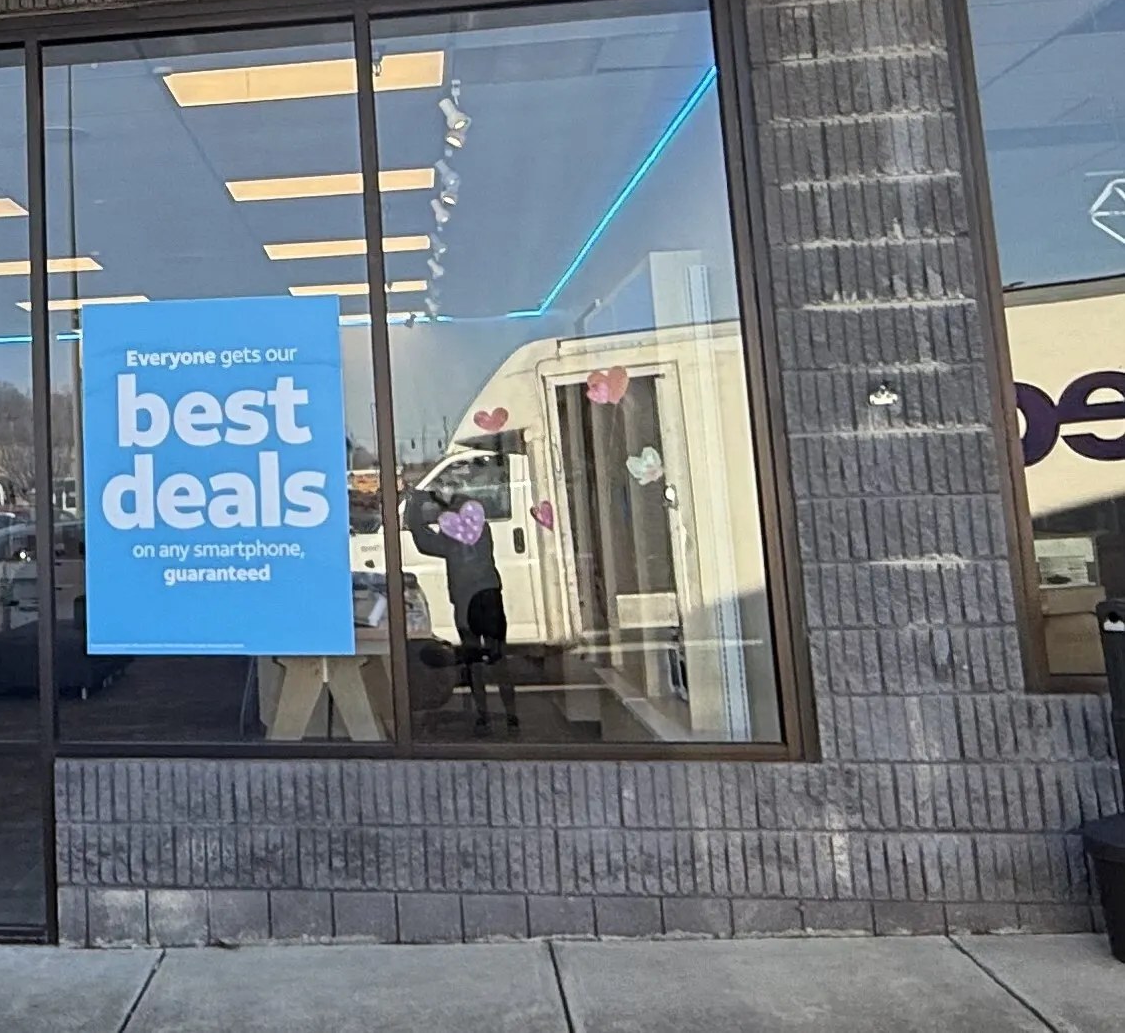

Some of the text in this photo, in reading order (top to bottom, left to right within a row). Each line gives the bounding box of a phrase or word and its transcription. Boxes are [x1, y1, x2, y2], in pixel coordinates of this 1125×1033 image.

[127, 347, 297, 370] Everyone gets our
[117, 373, 312, 447] best
[102, 451, 330, 530] deals
[133, 541, 305, 563] on any smartphone,
[164, 564, 271, 586] guaranteed
